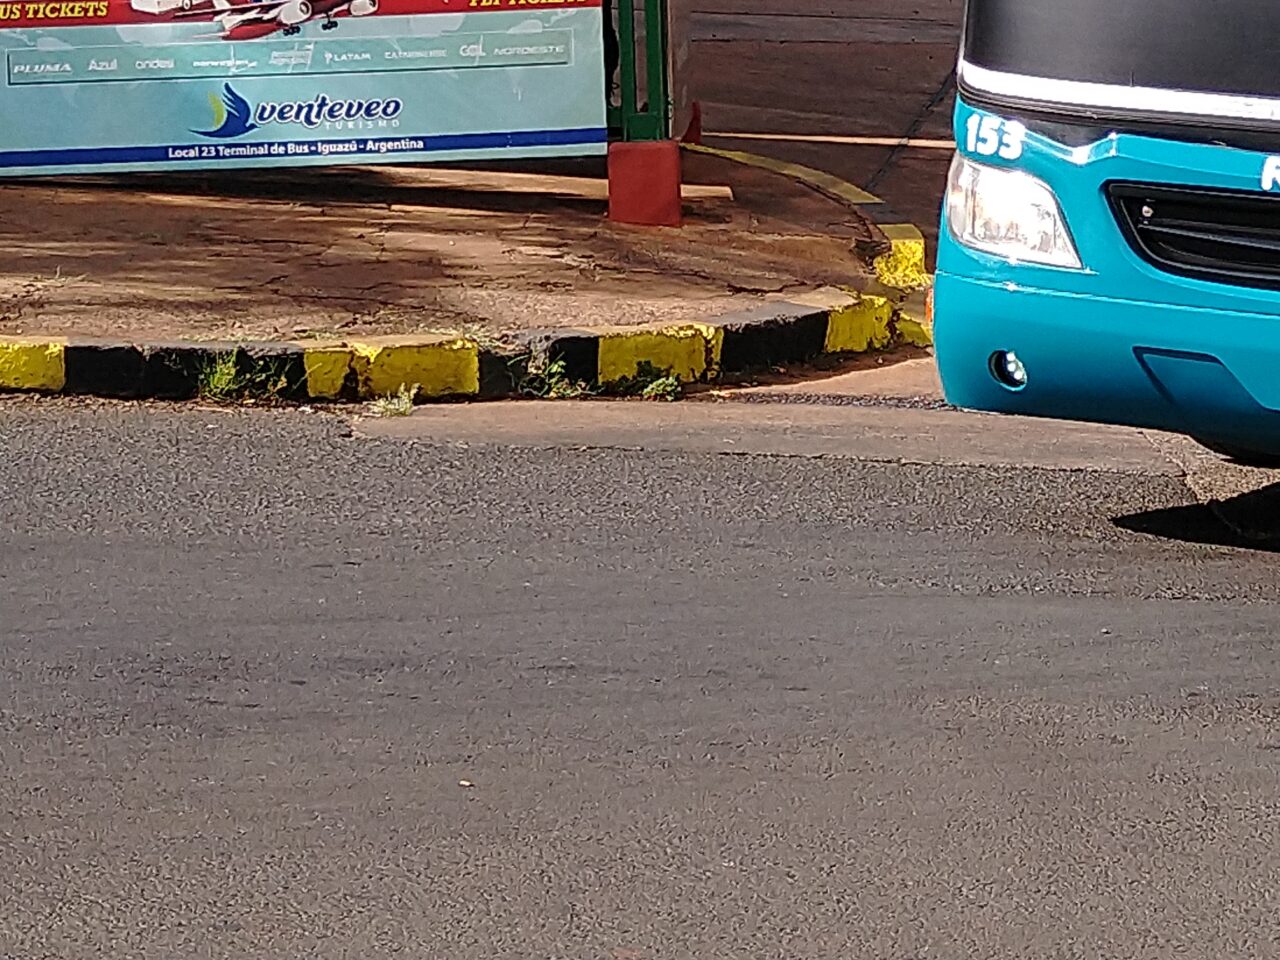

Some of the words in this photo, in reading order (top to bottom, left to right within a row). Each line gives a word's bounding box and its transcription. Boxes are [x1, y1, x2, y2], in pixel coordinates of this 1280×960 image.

[0, 3, 21, 20] US
[25, 1, 108, 19] TICKETS
[333, 52, 371, 62] LATAM
[13, 63, 72, 74] PLUMA
[254, 93, 403, 129] venteveo
[324, 119, 400, 131] TURISMO
[965, 113, 1026, 160] 153
[168, 146, 200, 158] Local
[201, 146, 217, 157] 23
[217, 144, 269, 156] Terminal
[270, 143, 286, 154] de
[287, 142, 309, 153] Bus
[366, 138, 424, 153] Argentina
